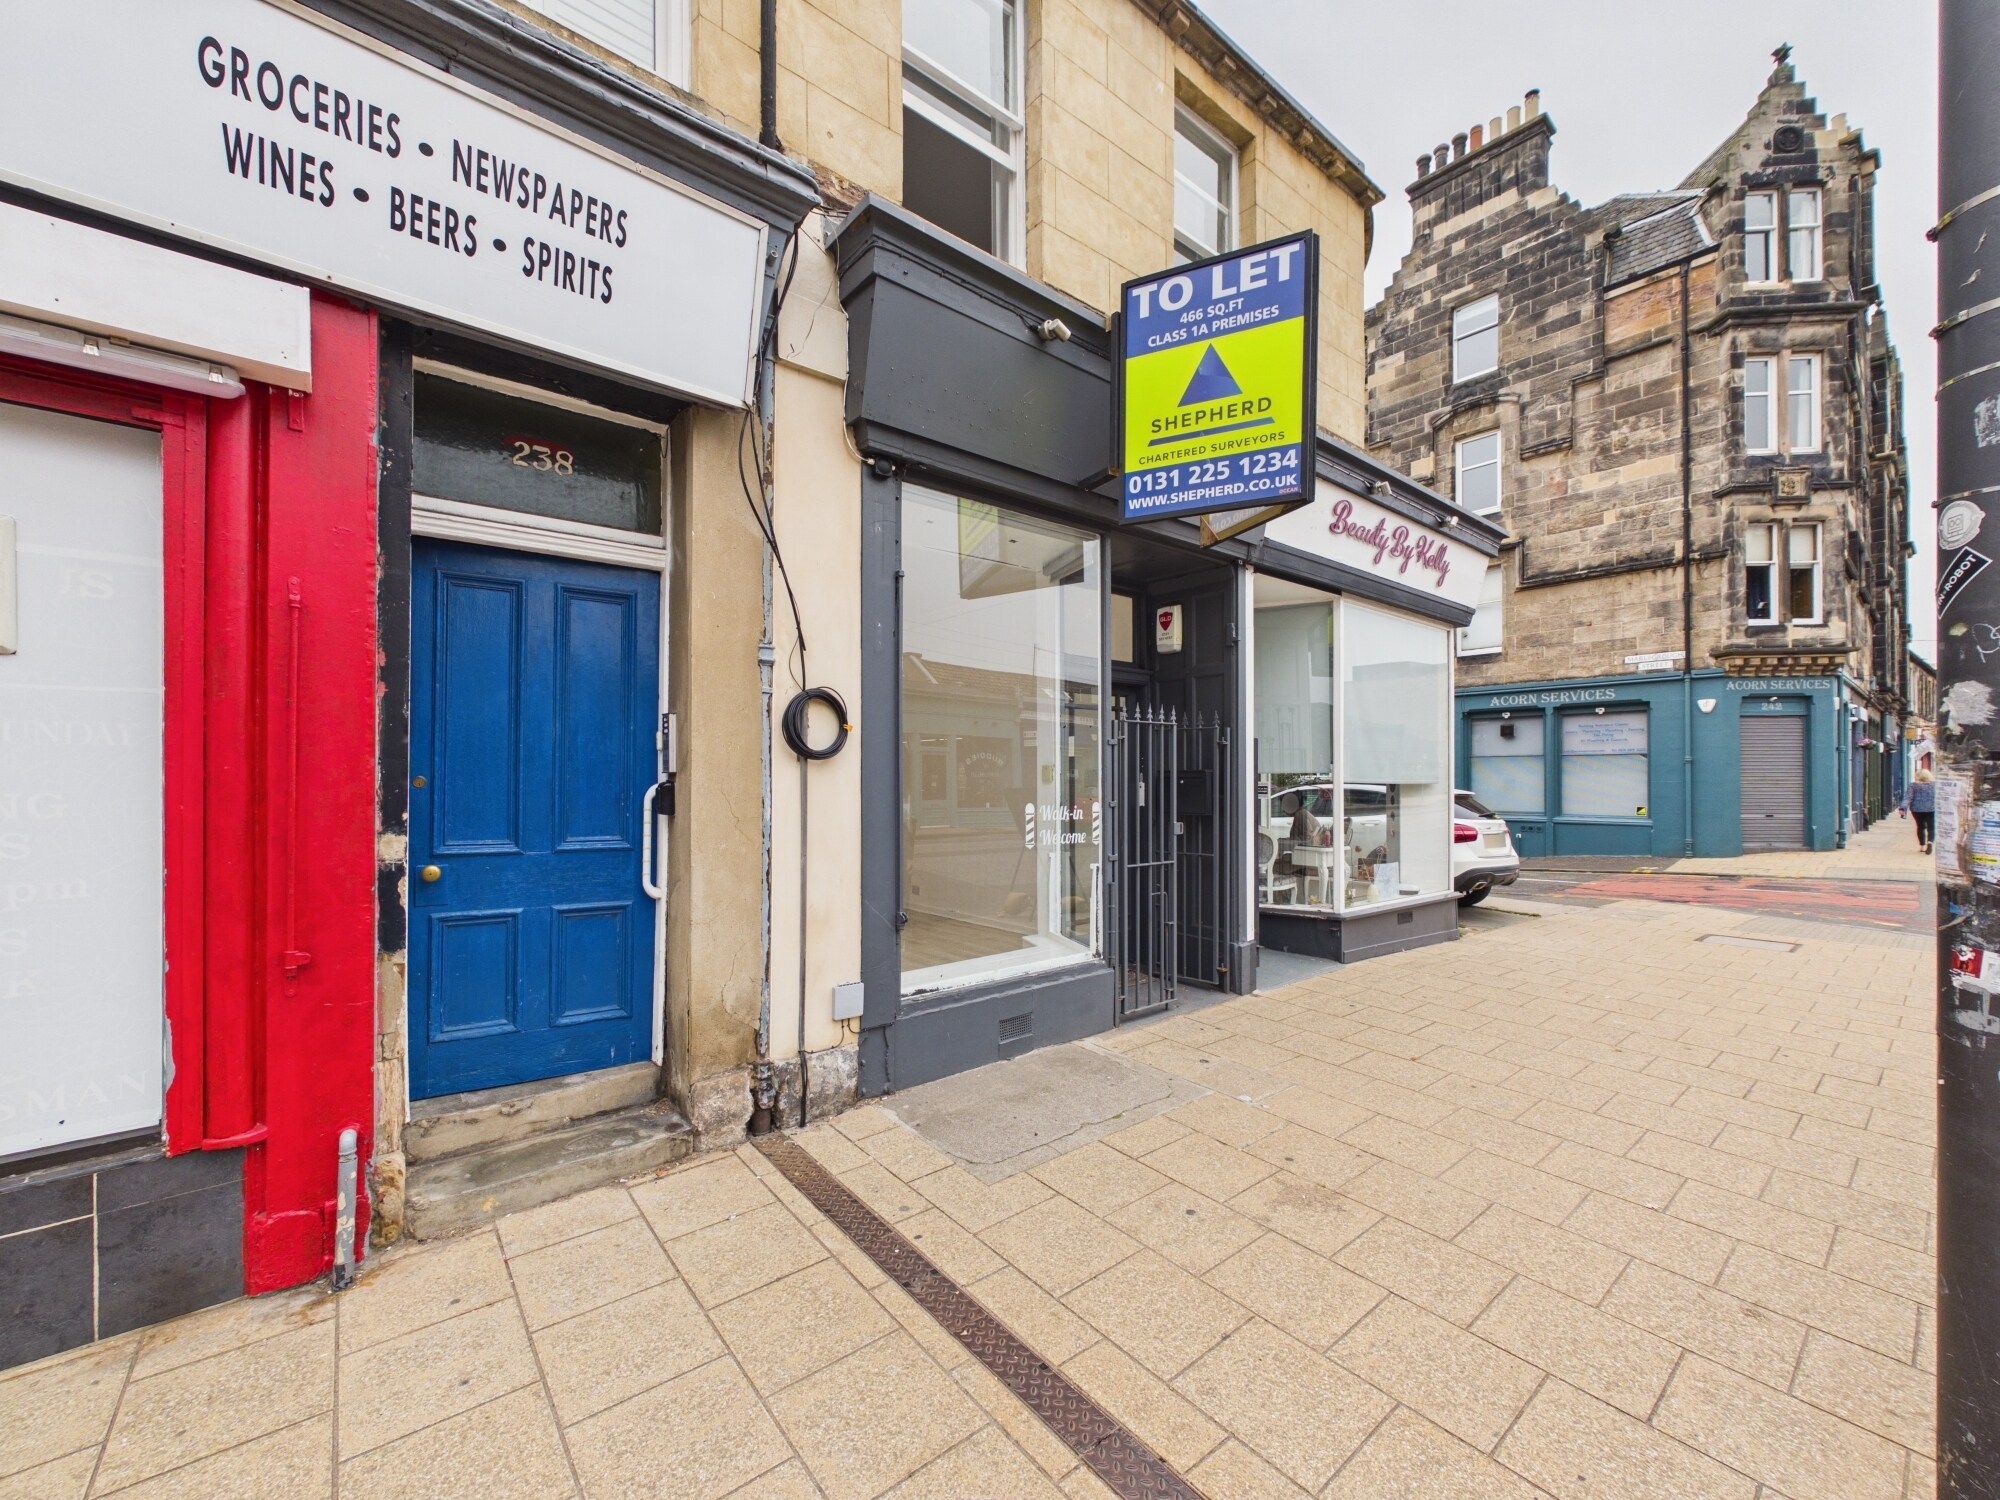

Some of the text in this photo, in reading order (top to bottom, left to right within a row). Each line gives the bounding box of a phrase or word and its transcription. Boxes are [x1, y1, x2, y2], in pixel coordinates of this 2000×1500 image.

[198, 36, 629, 249] GROCERIES NEWSPAPERS
[221, 122, 614, 305] WINES BEERS SPIRITS
[1132, 243, 1300, 319] TO LET
[1148, 304, 1280, 348] CLASS 1A PREMISES
[1180, 297, 1245, 324] 466 SQ.FT
[1151, 396, 1273, 434] SHEPHERD
[512, 441, 574, 476] 238
[1138, 431, 1286, 465] CHARTERED SURVEYORS
[1128, 449, 1299, 495] 0131 225 1234
[1128, 473, 1297, 510] WWW.SHEPHERD.CO.UK
[1329, 499, 1390, 565] Beauty
[1389, 525, 1415, 574] By
[1416, 534, 1451, 588] Kelly
[1489, 688, 1616, 707] ACORN SERVICES
[1726, 679, 1831, 691] ACORN SERVICES
[1761, 702, 1783, 711] 242
[1039, 804, 1084, 821] Walk-in
[1039, 829, 1087, 846] Welcome
